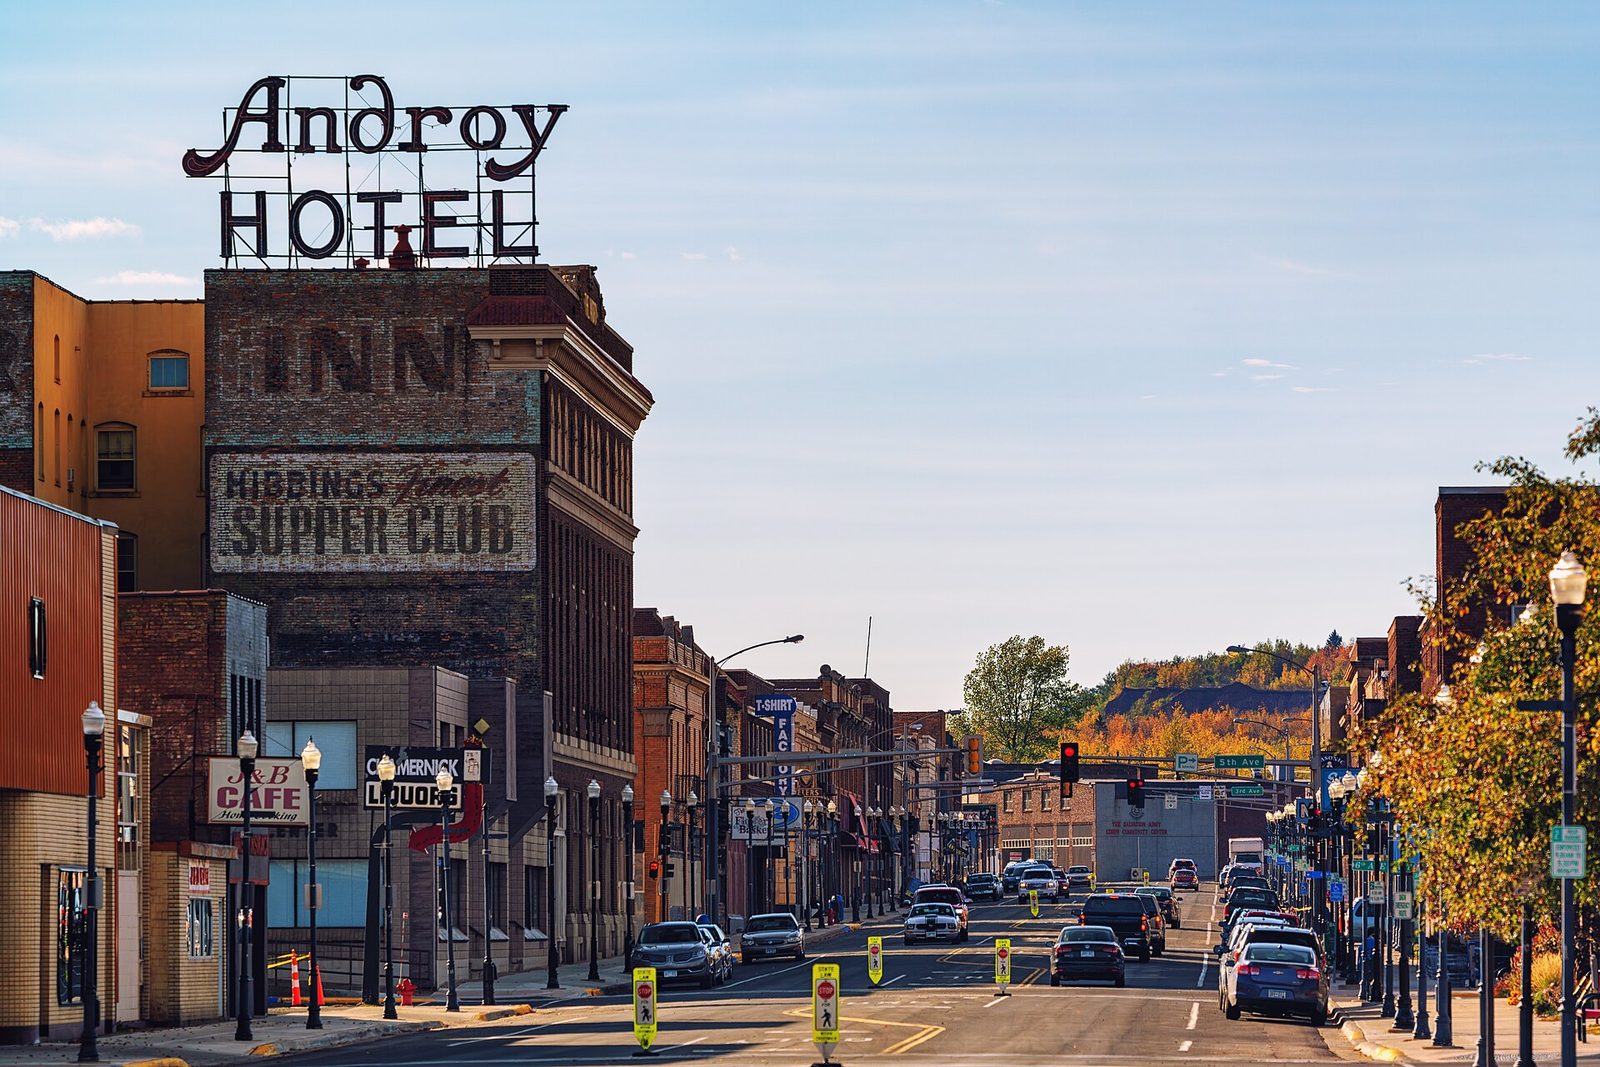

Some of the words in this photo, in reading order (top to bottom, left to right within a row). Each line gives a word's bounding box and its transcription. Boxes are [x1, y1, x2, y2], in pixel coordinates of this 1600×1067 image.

[182, 74, 568, 181] Androy
[220, 189, 539, 259] HOTEL
[226, 468, 384, 500] HIBBINGS
[232, 504, 388, 555] SUPPER
[406, 504, 513, 554] CLUB
[756, 699, 793, 712] T-SHIRT
[366, 758, 459, 776] CMERNICK
[778, 718, 789, 796] FACORY
[1219, 757, 1237, 766] 5th
[1241, 758, 1260, 766] Ave
[216, 786, 301, 810] CAFE
[269, 824, 338, 838] ENER
[638, 987, 652, 995] STOP
[818, 986, 834, 995] STOP
